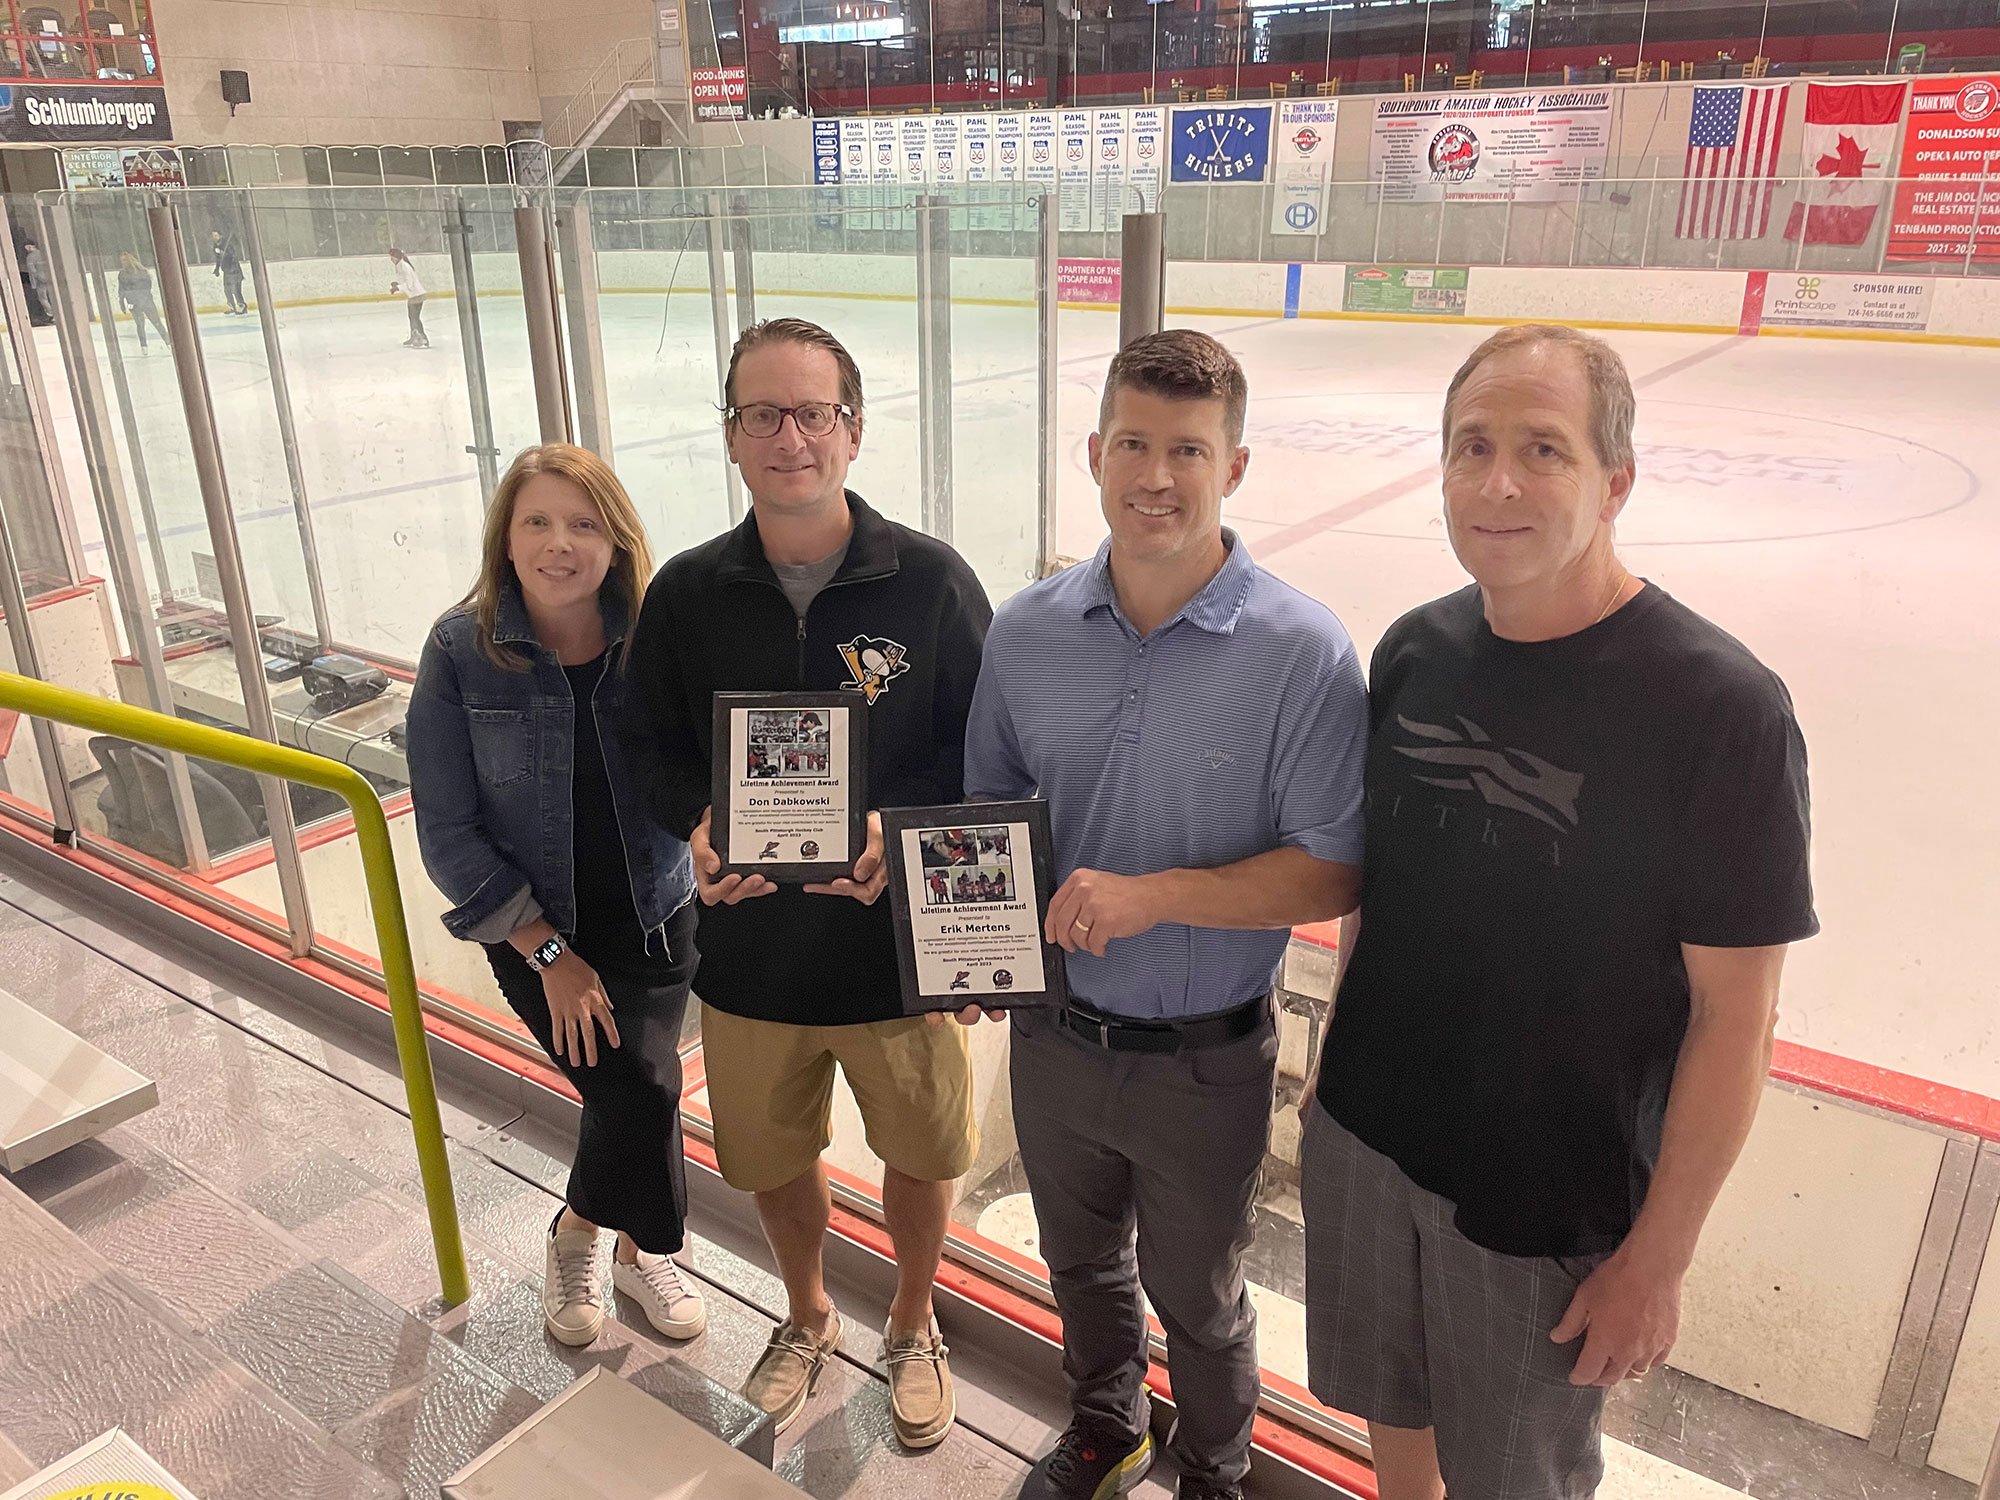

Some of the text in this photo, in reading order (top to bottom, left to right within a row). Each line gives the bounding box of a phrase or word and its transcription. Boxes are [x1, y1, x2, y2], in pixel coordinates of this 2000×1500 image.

[693, 72, 713, 80] FOOD
[718, 70, 744, 80] DRINKS
[694, 84, 744, 97] OPEN NOW
[1378, 92, 1609, 113] SOUTHPOINTE AMATEUR HOCKEY ASSOCIATION
[1913, 95, 1956, 110] THANK YOU
[1292, 103, 1326, 113] THANK YOU
[25, 97, 156, 130] Schlumberger
[1282, 113, 1335, 123] TO OUR SPONSORS
[1472, 110, 1504, 118] CORPORATE
[1961, 110, 1988, 118] HOCKEY
[1186, 113, 1255, 139] TRINITY
[1433, 124, 1472, 144] SOUTHPOINTE
[1918, 128, 2000, 139] DONALDSON SU
[71, 153, 112, 161] INTERIOR
[1916, 152, 1950, 161] OPEKA
[1952, 151, 1981, 160] AUTO
[75, 161, 119, 169] EXTERIOR
[1185, 152, 1254, 177] HILLERS
[1444, 192, 1516, 200] SOUTHPOINTEHOCKEY.OG
[1915, 192, 1934, 202] THE
[1935, 192, 1952, 202] JIM
[1912, 205, 1937, 215] REAL
[1939, 205, 1975, 214] ESTATE
[1894, 225, 1942, 234] TENBAND
[1926, 244, 1949, 253] 2021
[1064, 266, 1095, 274] PARTNER
[1096, 266, 1106, 274] OF
[1107, 267, 1120, 275] THE
[1089, 276, 1112, 284] ARENA
[1853, 284, 1923, 295] SPONSOR HERE!
[1775, 300, 1836, 311] Printscape
[1864, 301, 1888, 309] Contact
[749, 797, 830, 806] Don Dabkowski
[954, 905, 1001, 913] Achievement
[1003, 903, 1026, 911] Award
[940, 923, 1011, 934] Erik Mertens
